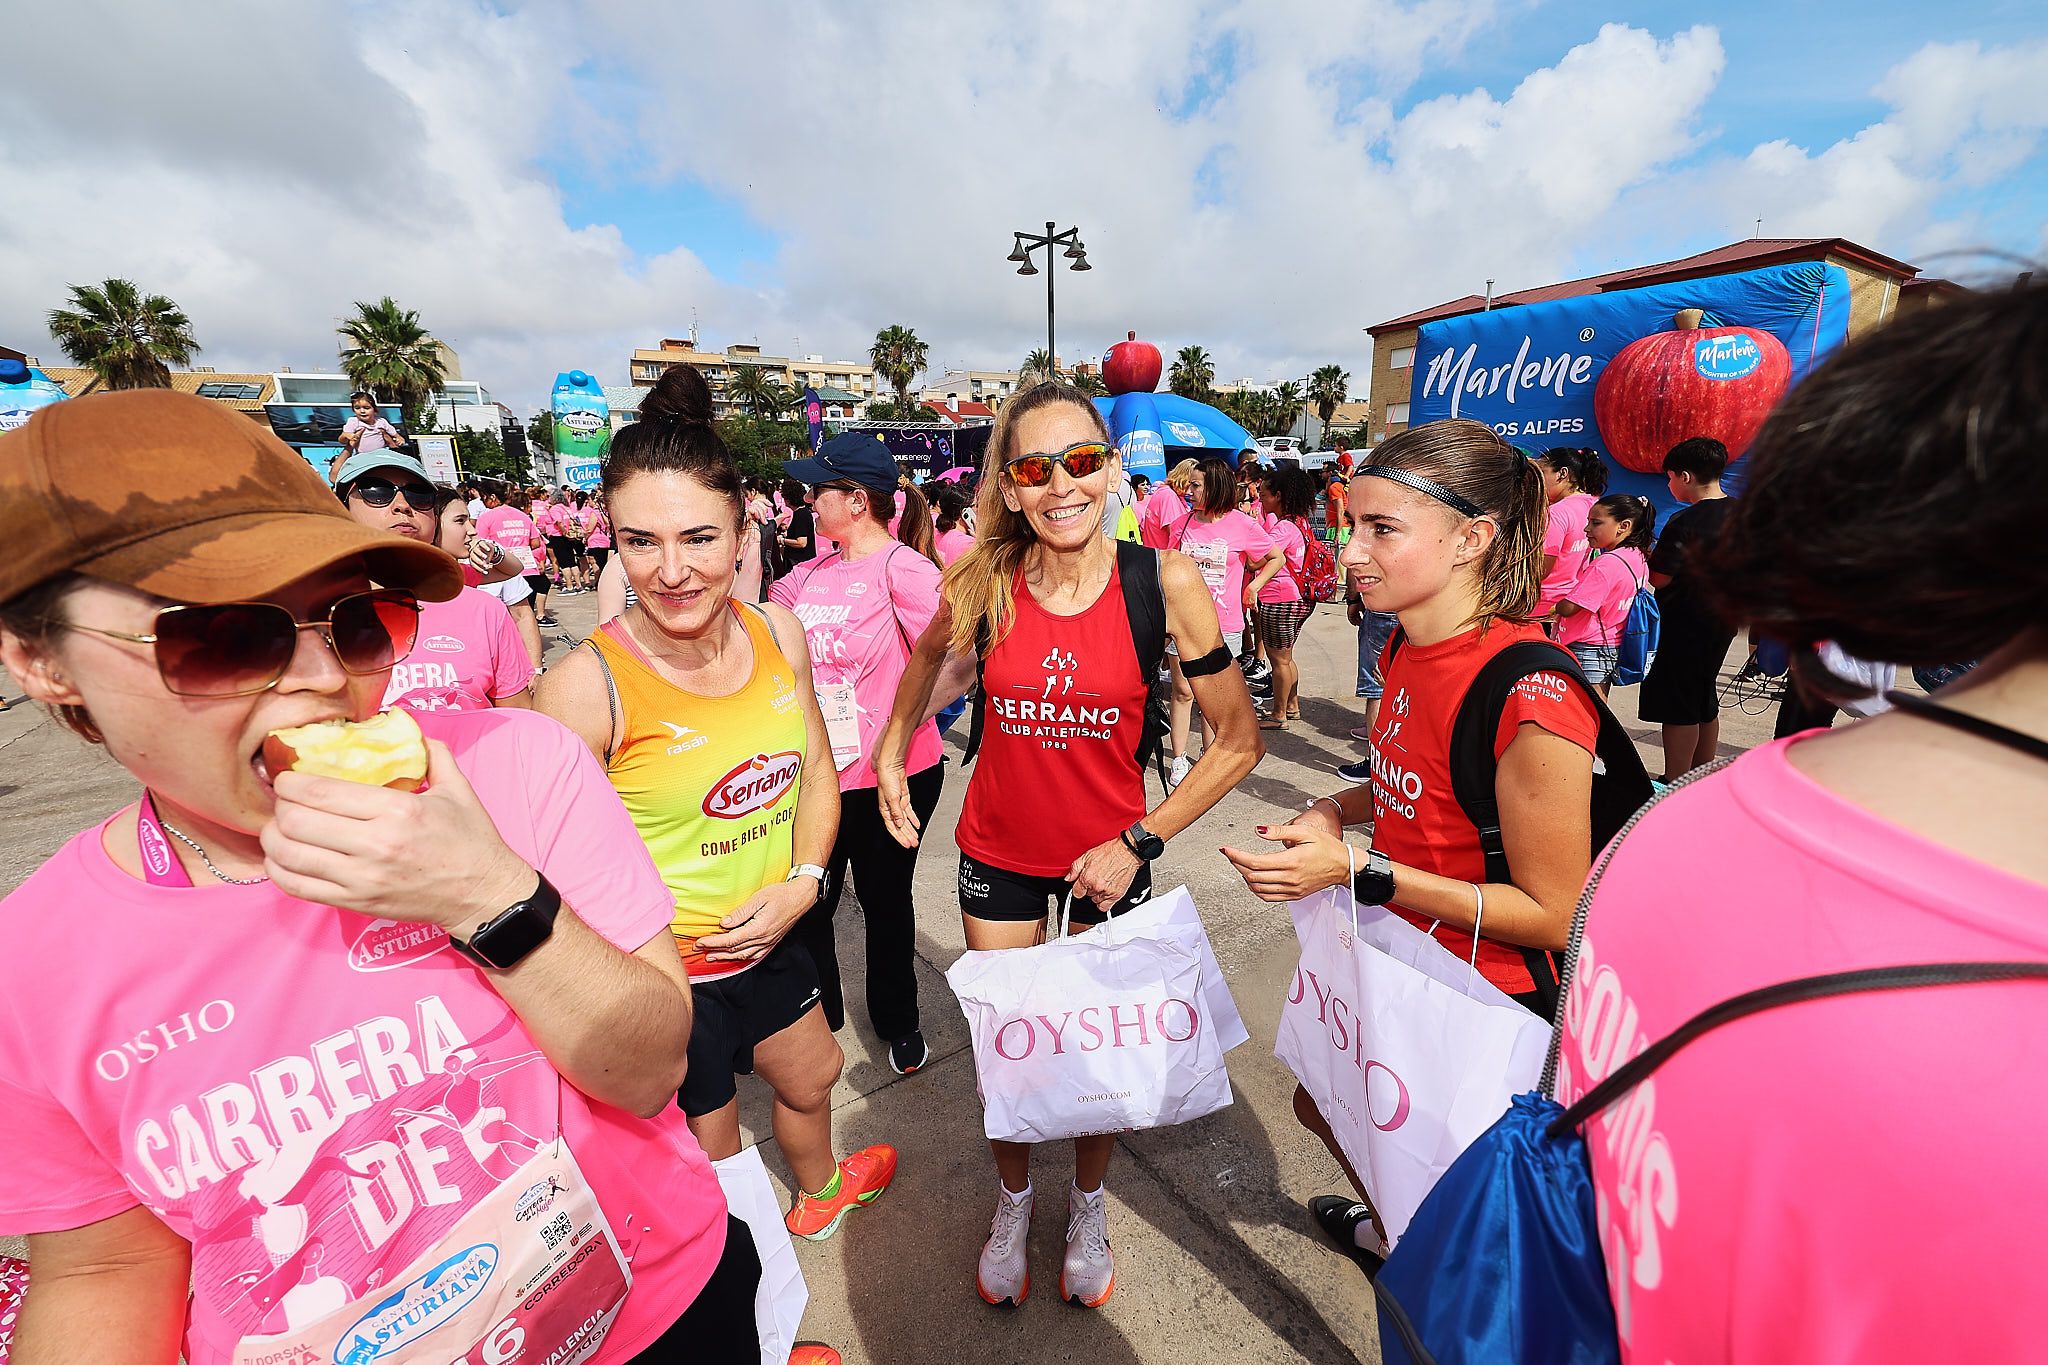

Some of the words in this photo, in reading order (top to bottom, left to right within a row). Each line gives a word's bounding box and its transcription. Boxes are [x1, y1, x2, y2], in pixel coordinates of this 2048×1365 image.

[1699, 341, 1757, 369] Marlene
[1423, 335, 1593, 419] Marlene
[1699, 364, 1729, 379] DAUGHTER
[1738, 367, 1750, 376] THE
[1522, 418, 1584, 436] ALPES
[1517, 684, 1563, 703] ATLETISMO
[992, 696, 1120, 725] SERRANO
[1000, 721, 1031, 736] CLUB
[1034, 725, 1111, 740] ATLETISMO
[1041, 740, 1067, 750] 1988
[716, 761, 798, 811] Serrano
[1369, 740, 1423, 801] RRANO
[142, 824, 165, 873] ASTURIANA
[701, 838, 738, 857] COME
[741, 823, 767, 846] BIEN
[357, 923, 449, 968] ASTURIA
[372, 923, 414, 943] CENTRAL
[994, 998, 1199, 1061] OYSHO
[134, 995, 478, 1201] CARRERA
[1077, 1090, 1132, 1104] OYSHO.COM
[340, 1117, 464, 1254] DE
[516, 1196, 544, 1222] Carrera
[354, 1258, 493, 1352] ASTURIANA
[372, 1294, 430, 1329] CENTRAL
[431, 1252, 480, 1292] LECHERA
[256, 1343, 312, 1365] DORSAL
